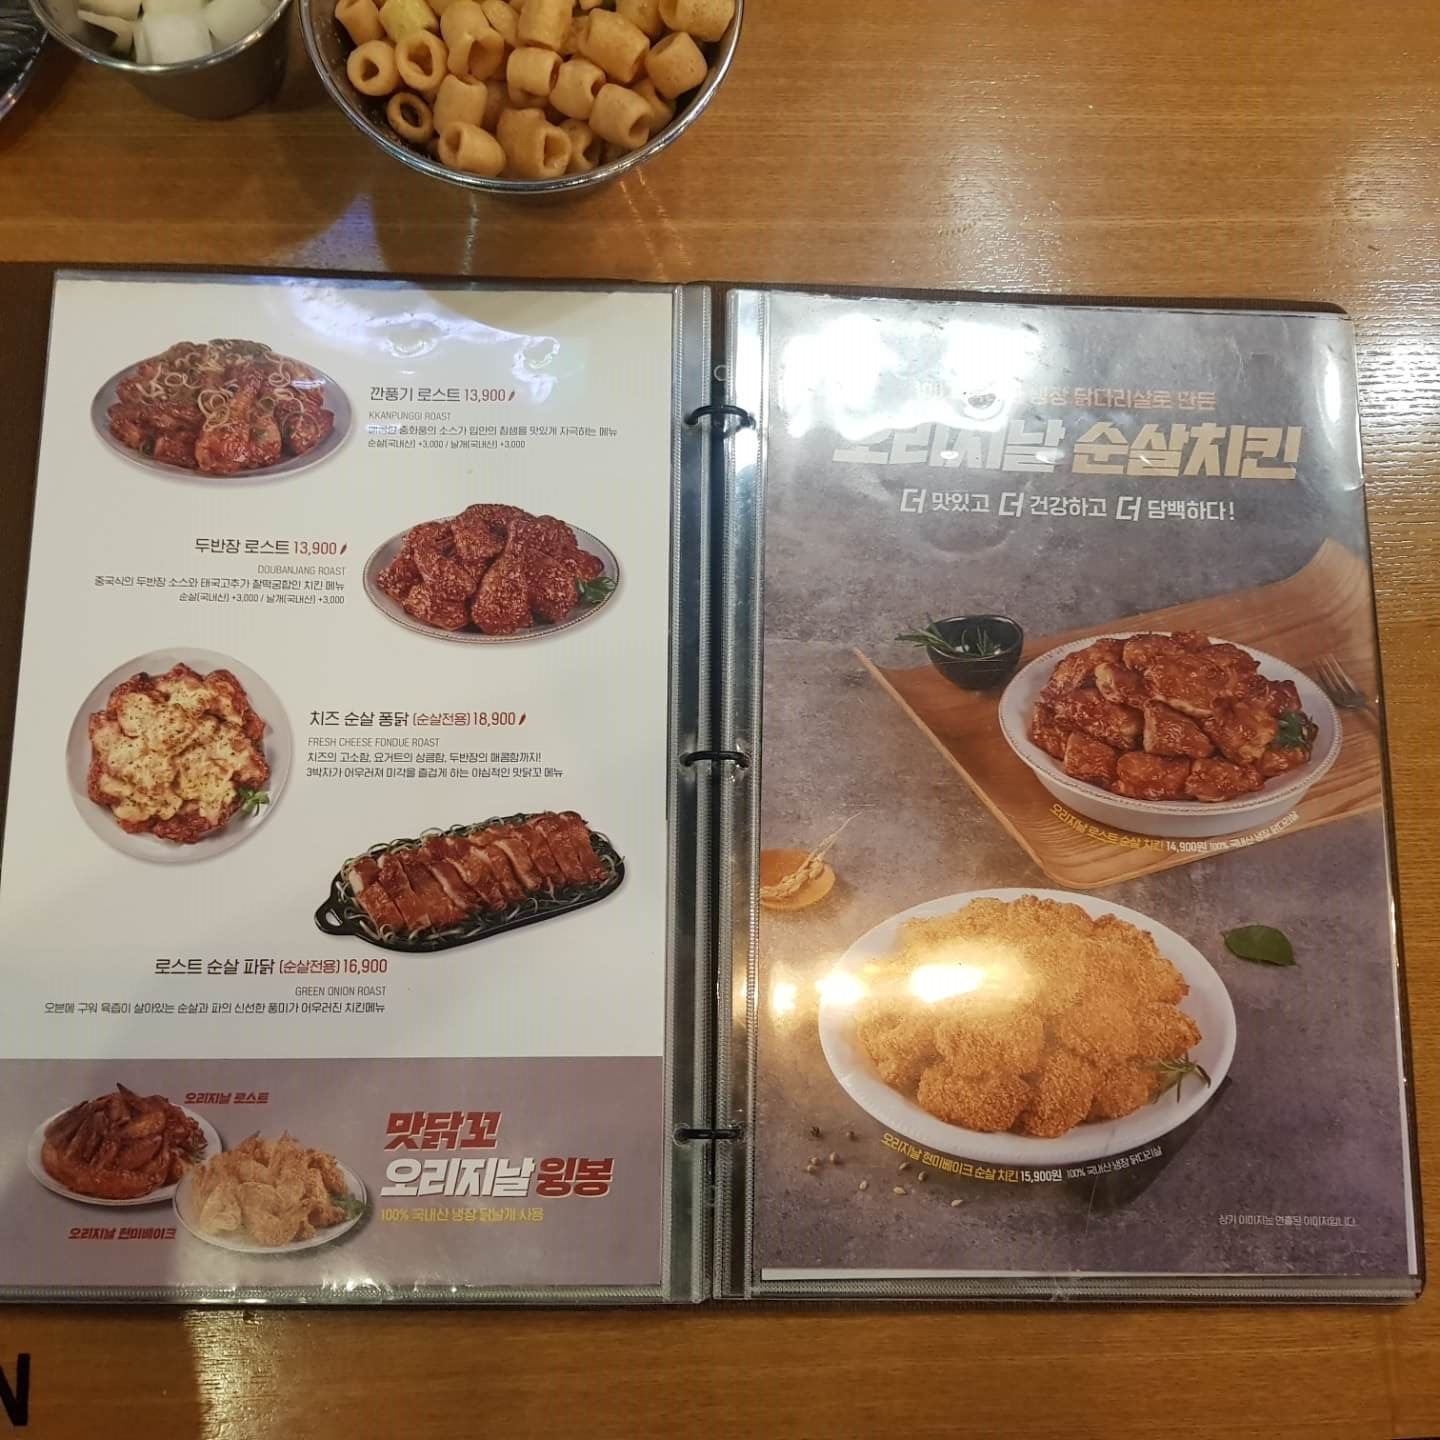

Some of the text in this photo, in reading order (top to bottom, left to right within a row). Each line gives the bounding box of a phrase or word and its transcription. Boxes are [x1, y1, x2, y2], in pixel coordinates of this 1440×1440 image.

[369, 386, 506, 403] 깐풍기 로스트 13,900
[1073, 386, 1217, 411] 닭다리살로 만든
[368, 411, 452, 421] KKANPUNGGI ROAST
[1072, 420, 1304, 480] 순살치킨
[900, 488, 1235, 522] 더 맛있고 더 건강하고 더 담백하다!
[195, 538, 337, 556] 두반장 로스트 13,900
[257, 564, 345, 576] DOUBANJANG ROAST
[136, 576, 323, 591] 두반장 치킨
[310, 710, 516, 728] 치즈 순살 퐁닭 (순살전용) 18,900
[308, 737, 441, 747] FRESH CHEESE FONDUE ROAST
[374, 752, 488, 763] 요거트의 두반장의
[418, 767, 448, 778] 즐겁게
[1049, 803, 1088, 833] 오리지날
[1087, 825, 1119, 846] 로스트
[1166, 840, 1207, 853] 14,900원
[155, 958, 388, 975] 로스트 순살 파닭 (순살전용) 16,900
[295, 986, 386, 996] GREEN ONION ROAST
[301, 1002, 342, 1014] 어우러진
[184, 1092, 270, 1105] 오리지날 로스트
[384, 1110, 503, 1151] 맛닭꼬
[380, 1156, 615, 1199] 오리지날 윙봉
[1020, 1169, 1063, 1183] 15,900원
[382, 1208, 545, 1222] 100% 냉장 닭날개 사용
[1218, 1213, 1237, 1226] 상기
[68, 1227, 117, 1241] 오리지날
